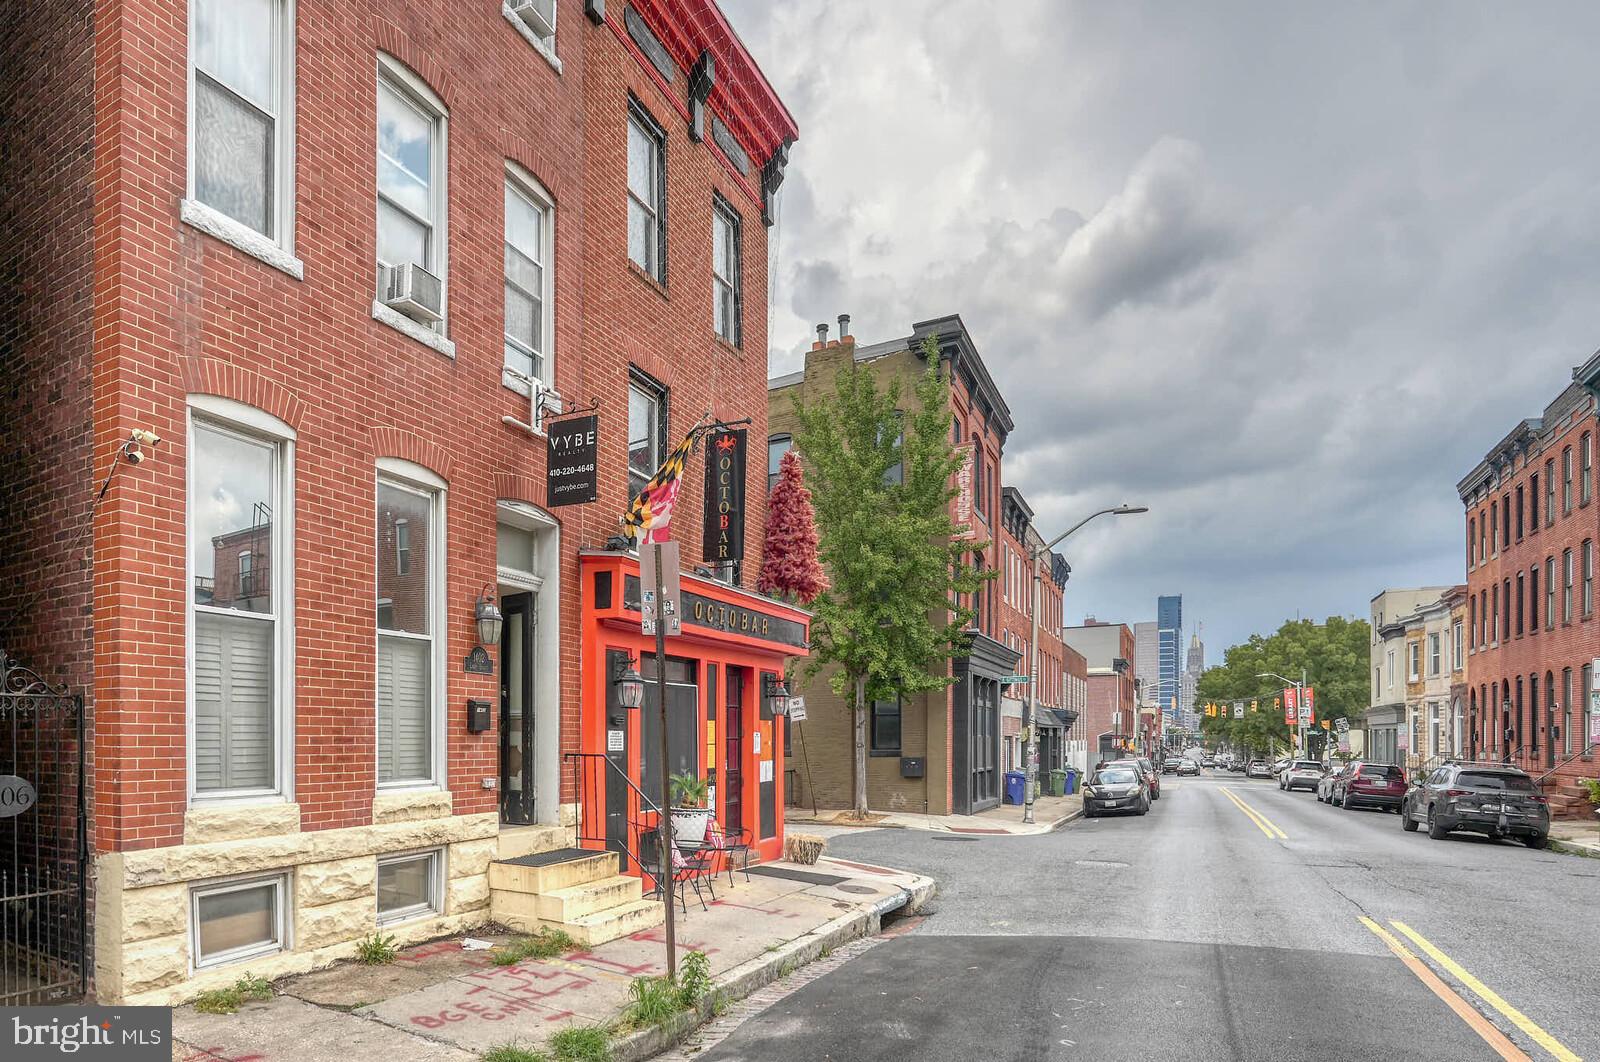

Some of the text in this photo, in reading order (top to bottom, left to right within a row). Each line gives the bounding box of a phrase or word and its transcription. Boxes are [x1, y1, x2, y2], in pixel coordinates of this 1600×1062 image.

[550, 431, 595, 450] VYBE
[558, 448, 585, 457] REALTY
[549, 464, 594, 477] 410-220-4648
[554, 482, 590, 494] justvybe.com
[719, 458, 730, 558] OCTOBAR
[695, 600, 769, 635] OCTOBAR
